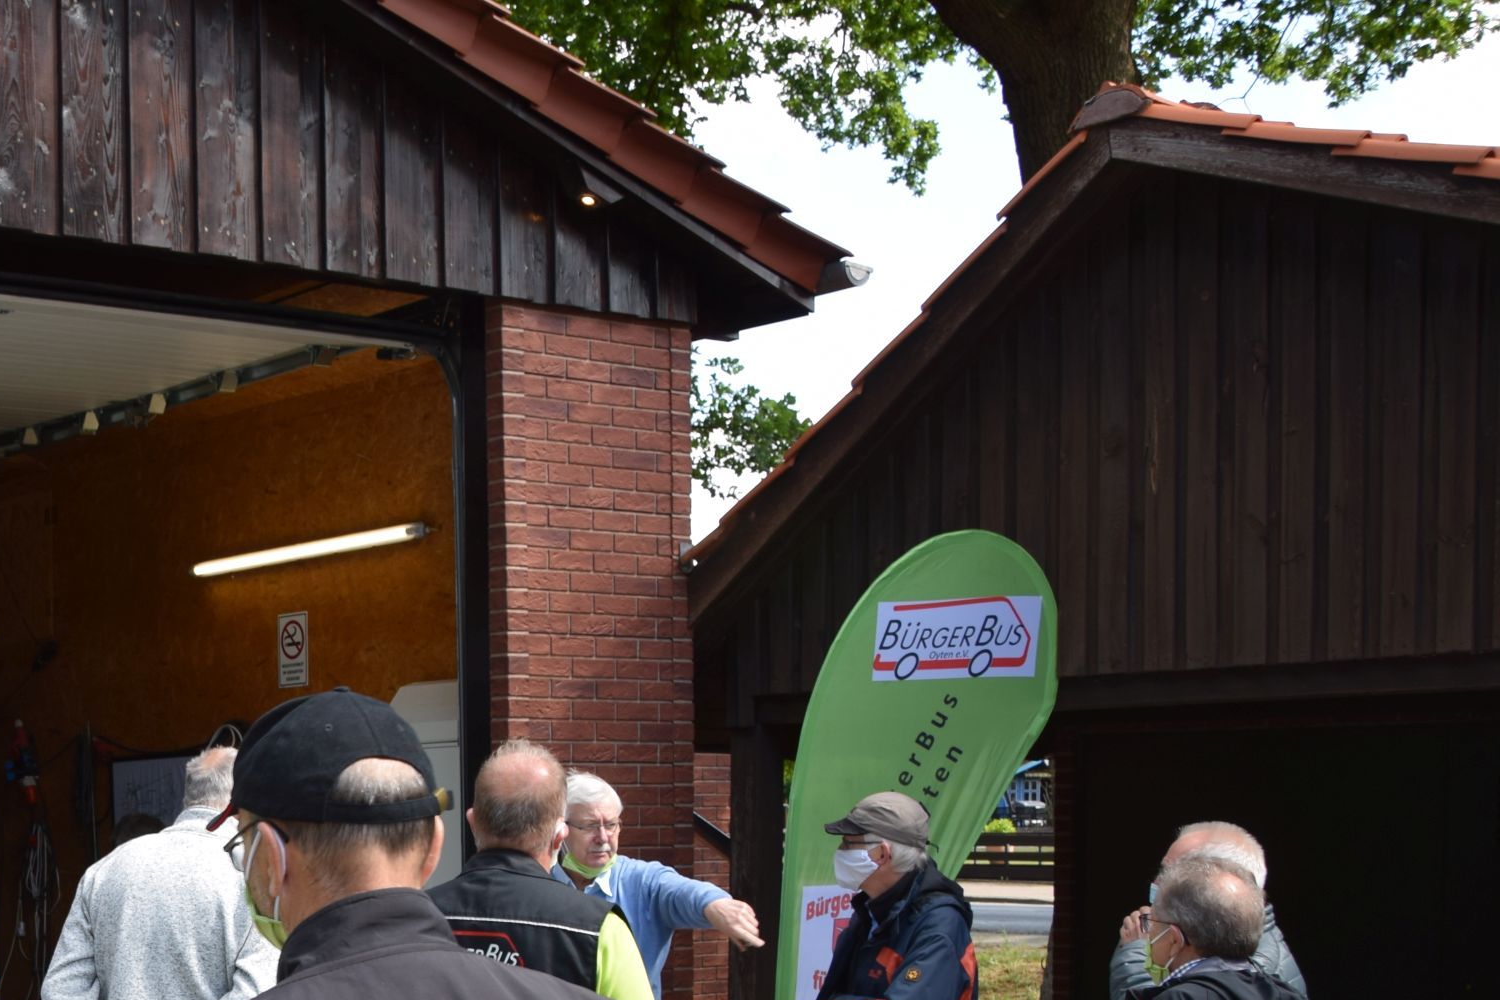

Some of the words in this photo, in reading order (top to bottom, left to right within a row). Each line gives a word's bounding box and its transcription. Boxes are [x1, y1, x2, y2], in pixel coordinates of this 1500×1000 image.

[929, 650, 954, 661] Oyten
[897, 693, 959, 787] erBus
[921, 745, 964, 800] ten
[805, 890, 856, 921] Bürge
[812, 969, 828, 991] fü
